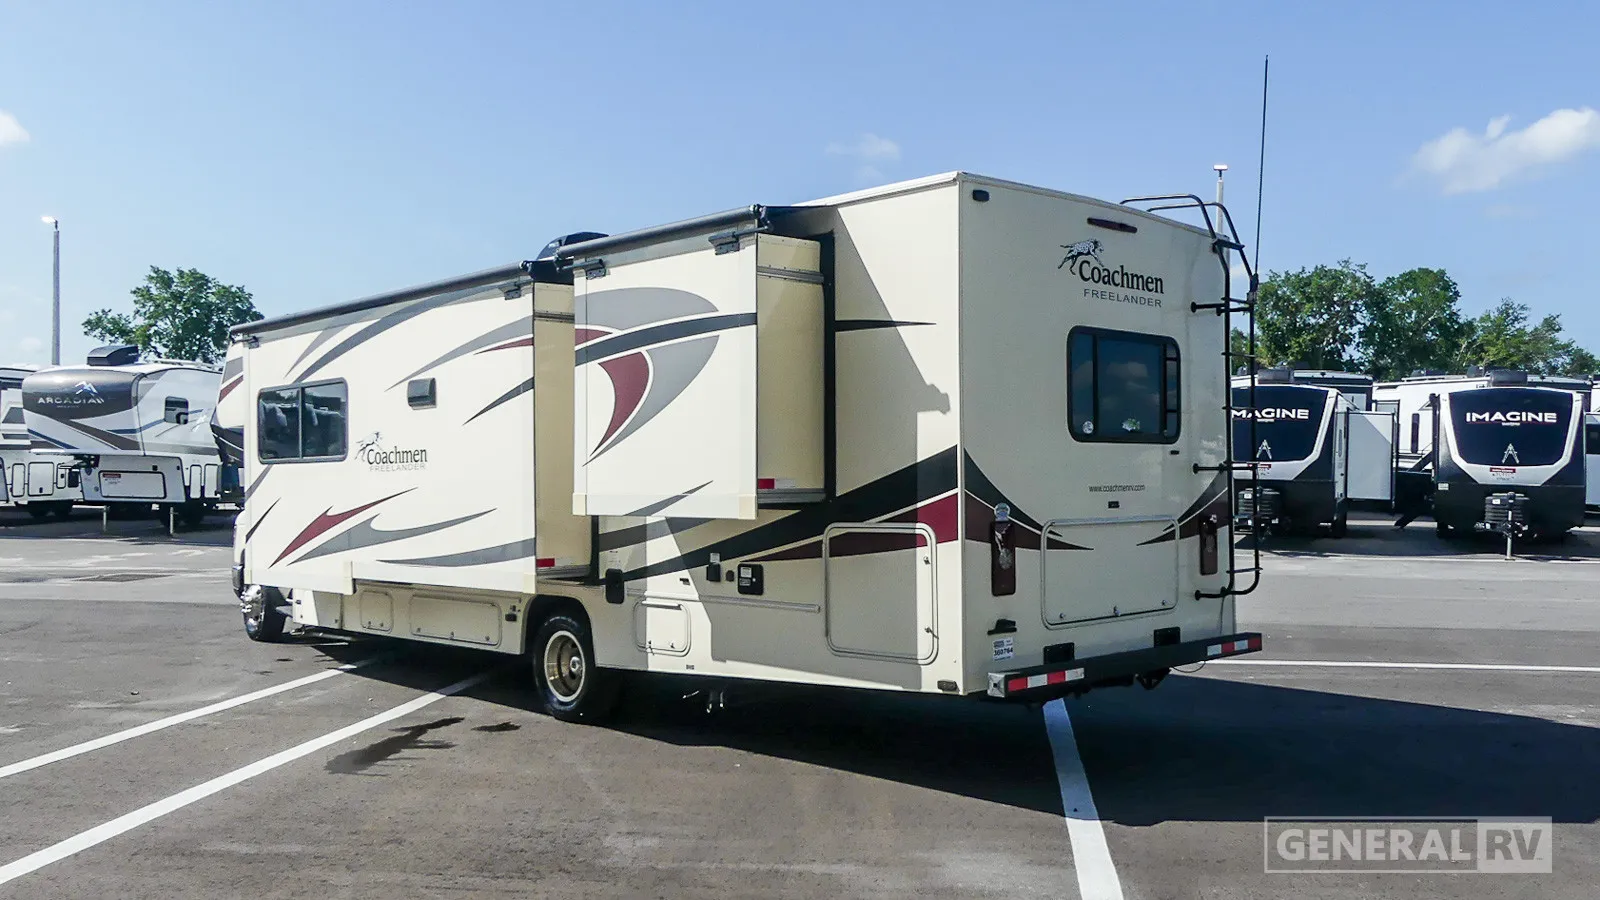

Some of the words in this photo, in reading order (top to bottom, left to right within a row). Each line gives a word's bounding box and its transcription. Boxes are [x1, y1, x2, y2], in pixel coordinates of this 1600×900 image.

[1078, 260, 1165, 294] Coachmen
[1083, 288, 1162, 308] FREELANDER
[1231, 408, 1310, 419] MAGINE
[1466, 411, 1557, 423] IMAGINE
[366, 446, 428, 465] Coachmen
[369, 463, 426, 472] FREELANDER
